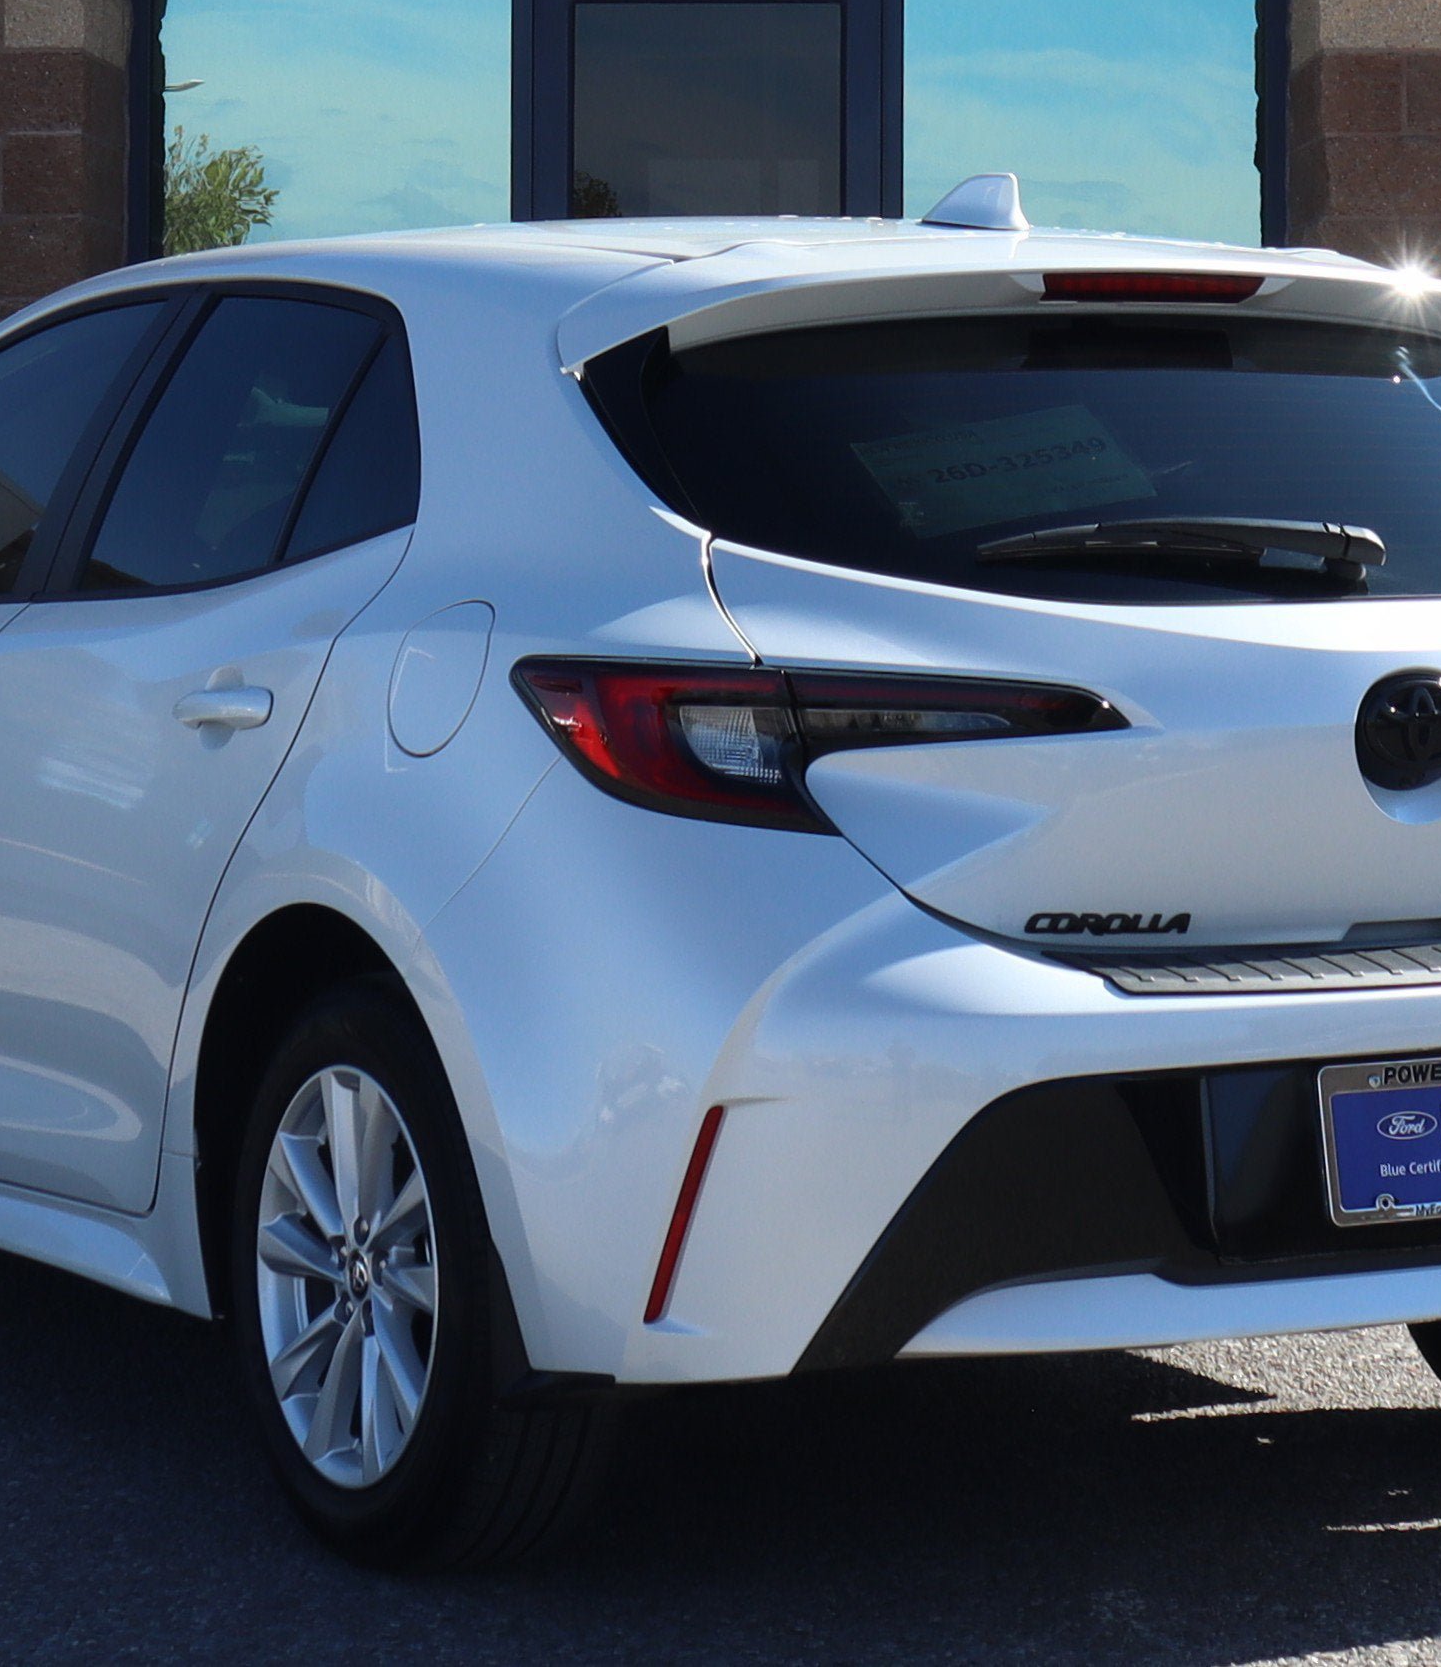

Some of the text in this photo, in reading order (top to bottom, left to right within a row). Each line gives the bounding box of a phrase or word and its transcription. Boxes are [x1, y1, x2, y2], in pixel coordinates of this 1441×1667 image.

[1023, 912, 1192, 936] COROLLA
[1388, 1115, 1426, 1137] Ford
[1380, 1163, 1406, 1178] Blue
